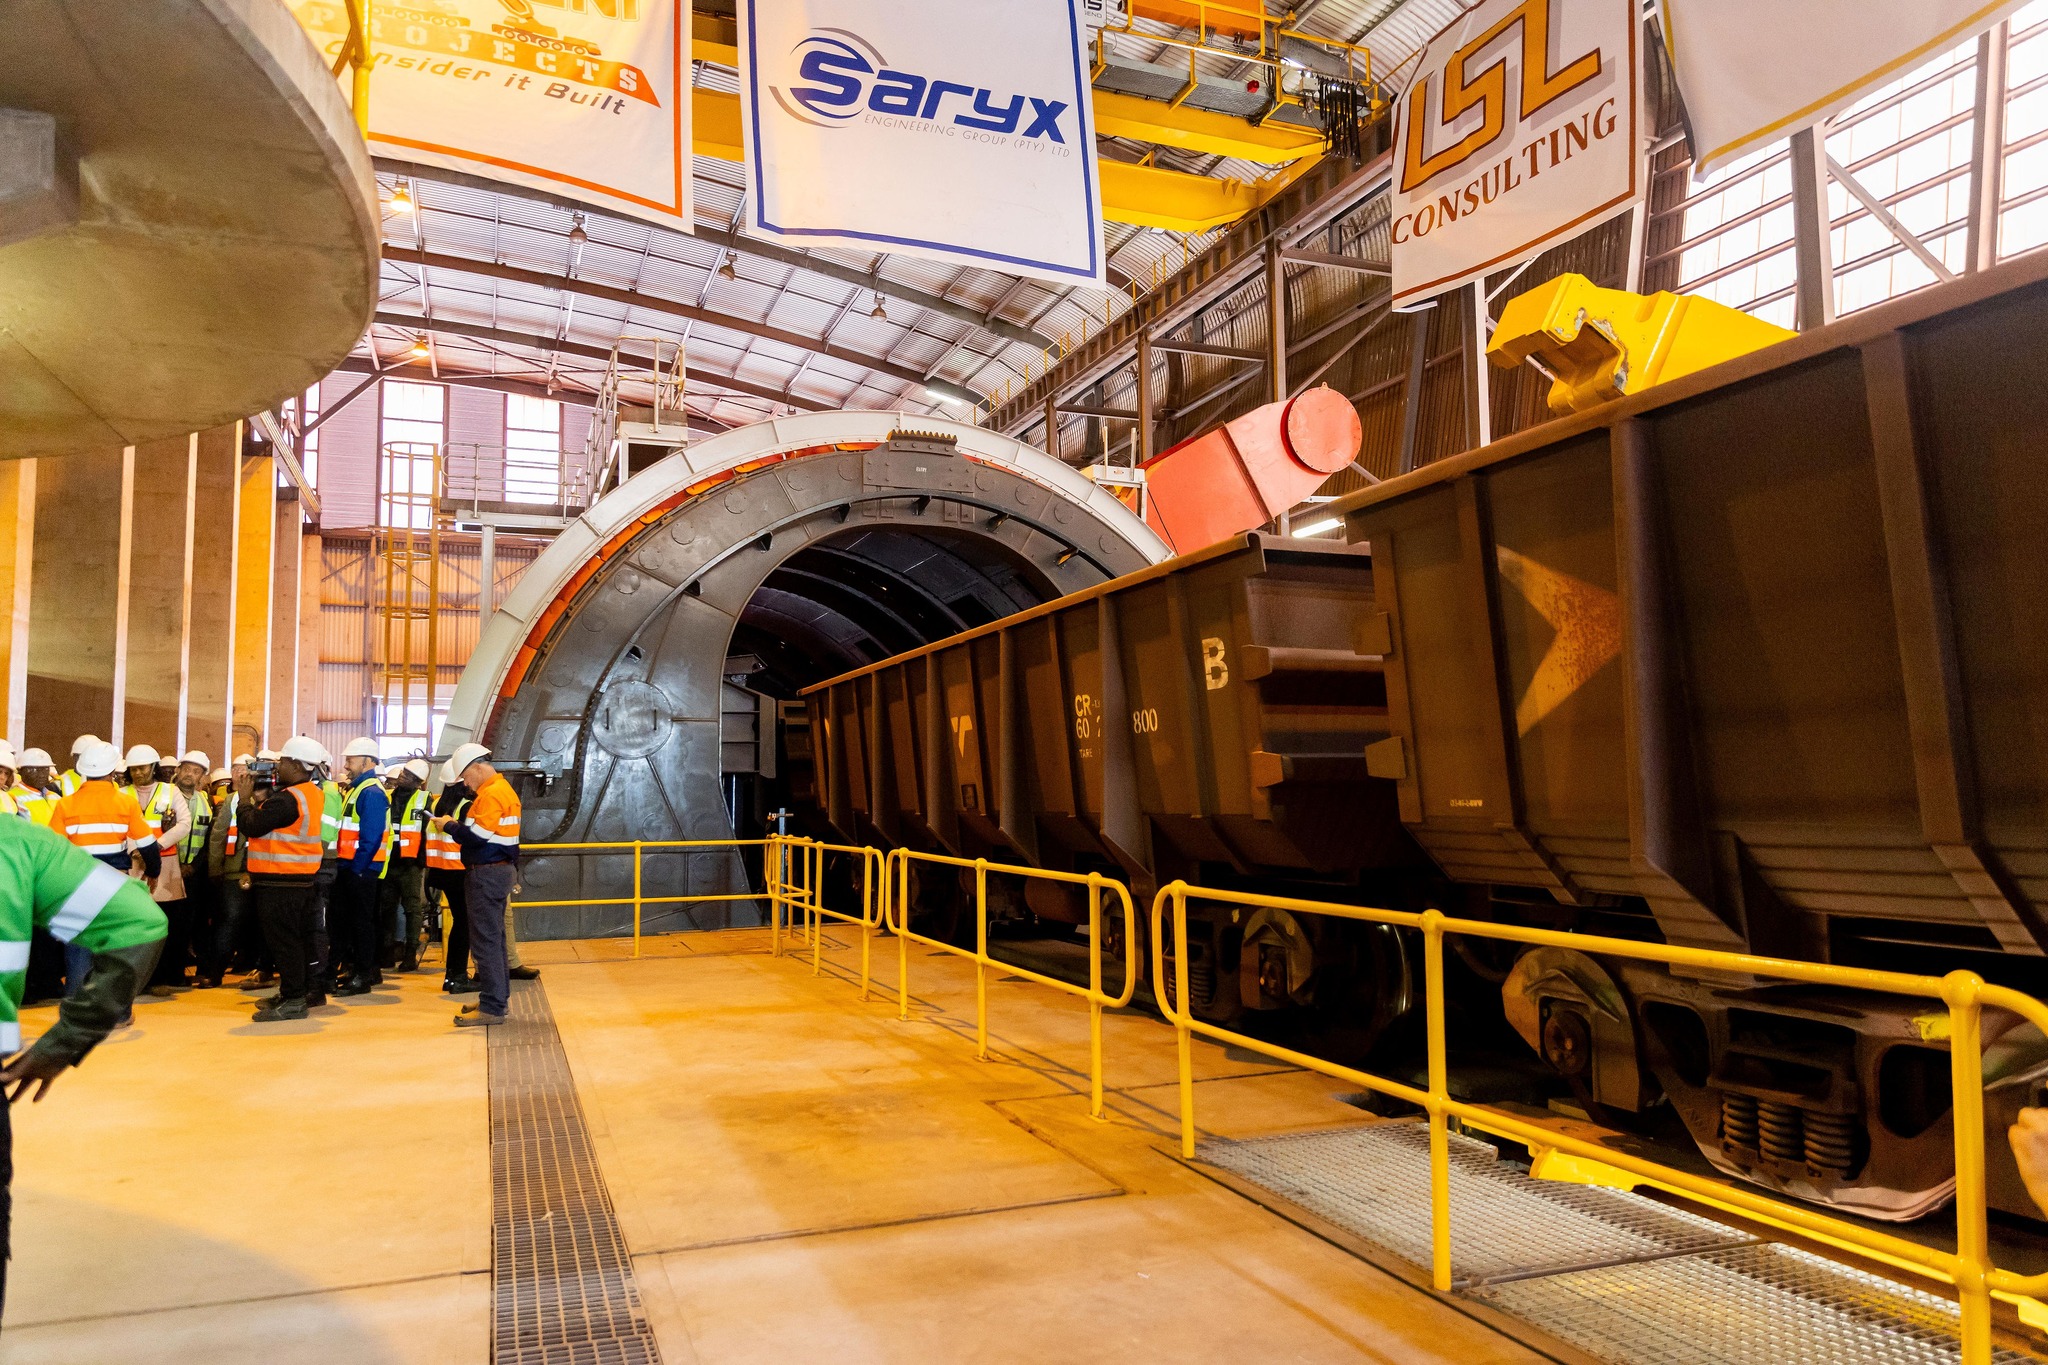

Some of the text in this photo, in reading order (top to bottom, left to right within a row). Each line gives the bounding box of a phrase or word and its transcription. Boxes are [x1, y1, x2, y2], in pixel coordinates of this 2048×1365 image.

[325, 40, 626, 115] Cnsider it Built
[789, 37, 1069, 145] Saryx
[864, 113, 1070, 157] ENGINEERING GROUP (PTY) LTD
[1392, 97, 1618, 245] CONSULTING
[1201, 637, 1229, 691] B
[1133, 708, 1158, 734] 800
